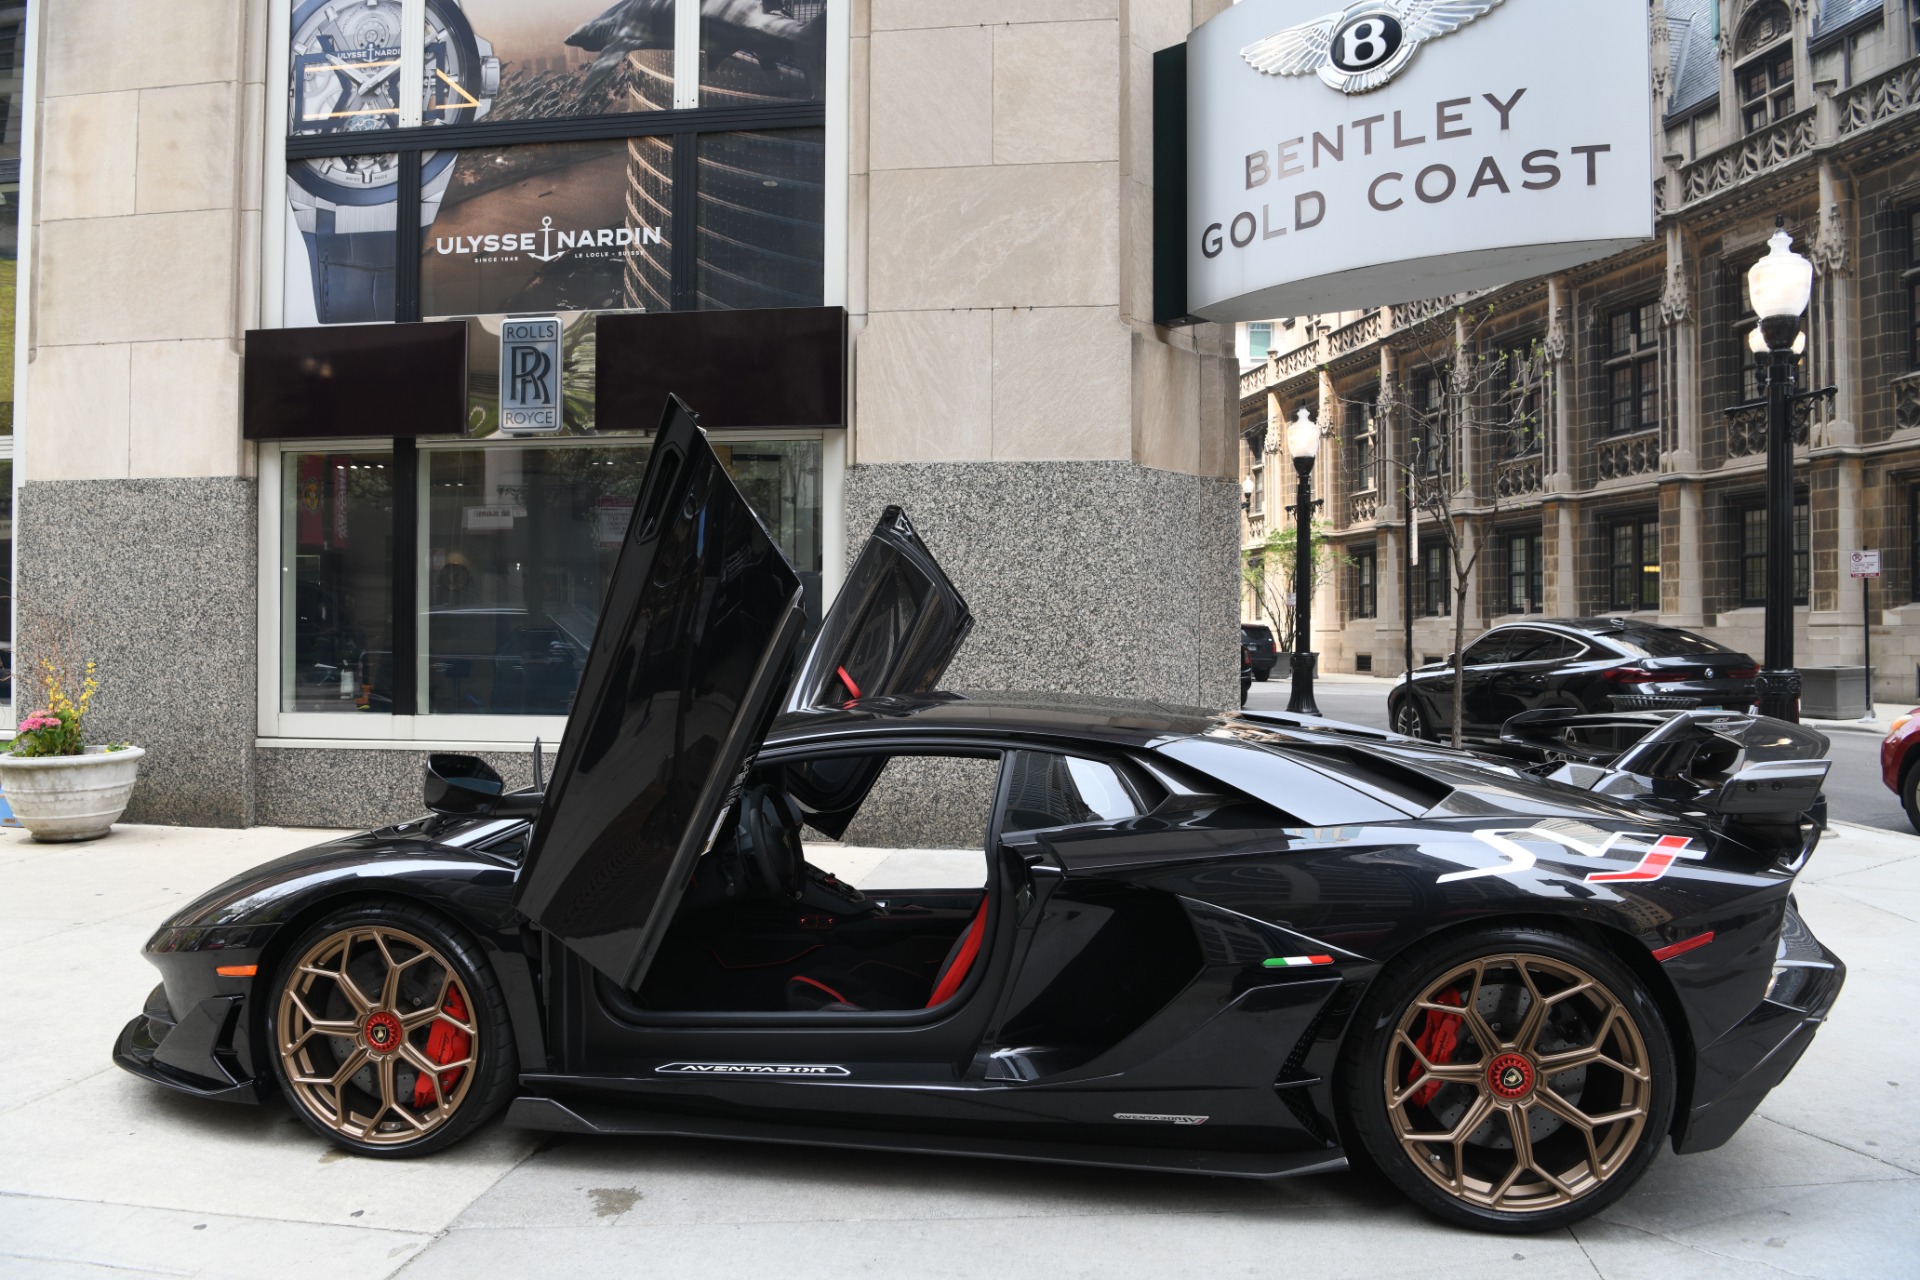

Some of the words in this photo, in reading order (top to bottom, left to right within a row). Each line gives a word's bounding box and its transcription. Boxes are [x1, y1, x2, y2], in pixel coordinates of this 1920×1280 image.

[1342, 18, 1387, 67] B
[337, 51, 367, 59] ULYSSE
[1245, 88, 1528, 190] BENTLEY
[1201, 190, 1326, 259] GOLD
[1367, 143, 1611, 212] COAST
[436, 232, 536, 255] ULYSSE
[557, 226, 663, 249] NARDIN
[506, 325, 554, 339] ROLLS
[505, 411, 553, 425] ROYCE
[681, 1065, 828, 1073] AVENTADOR
